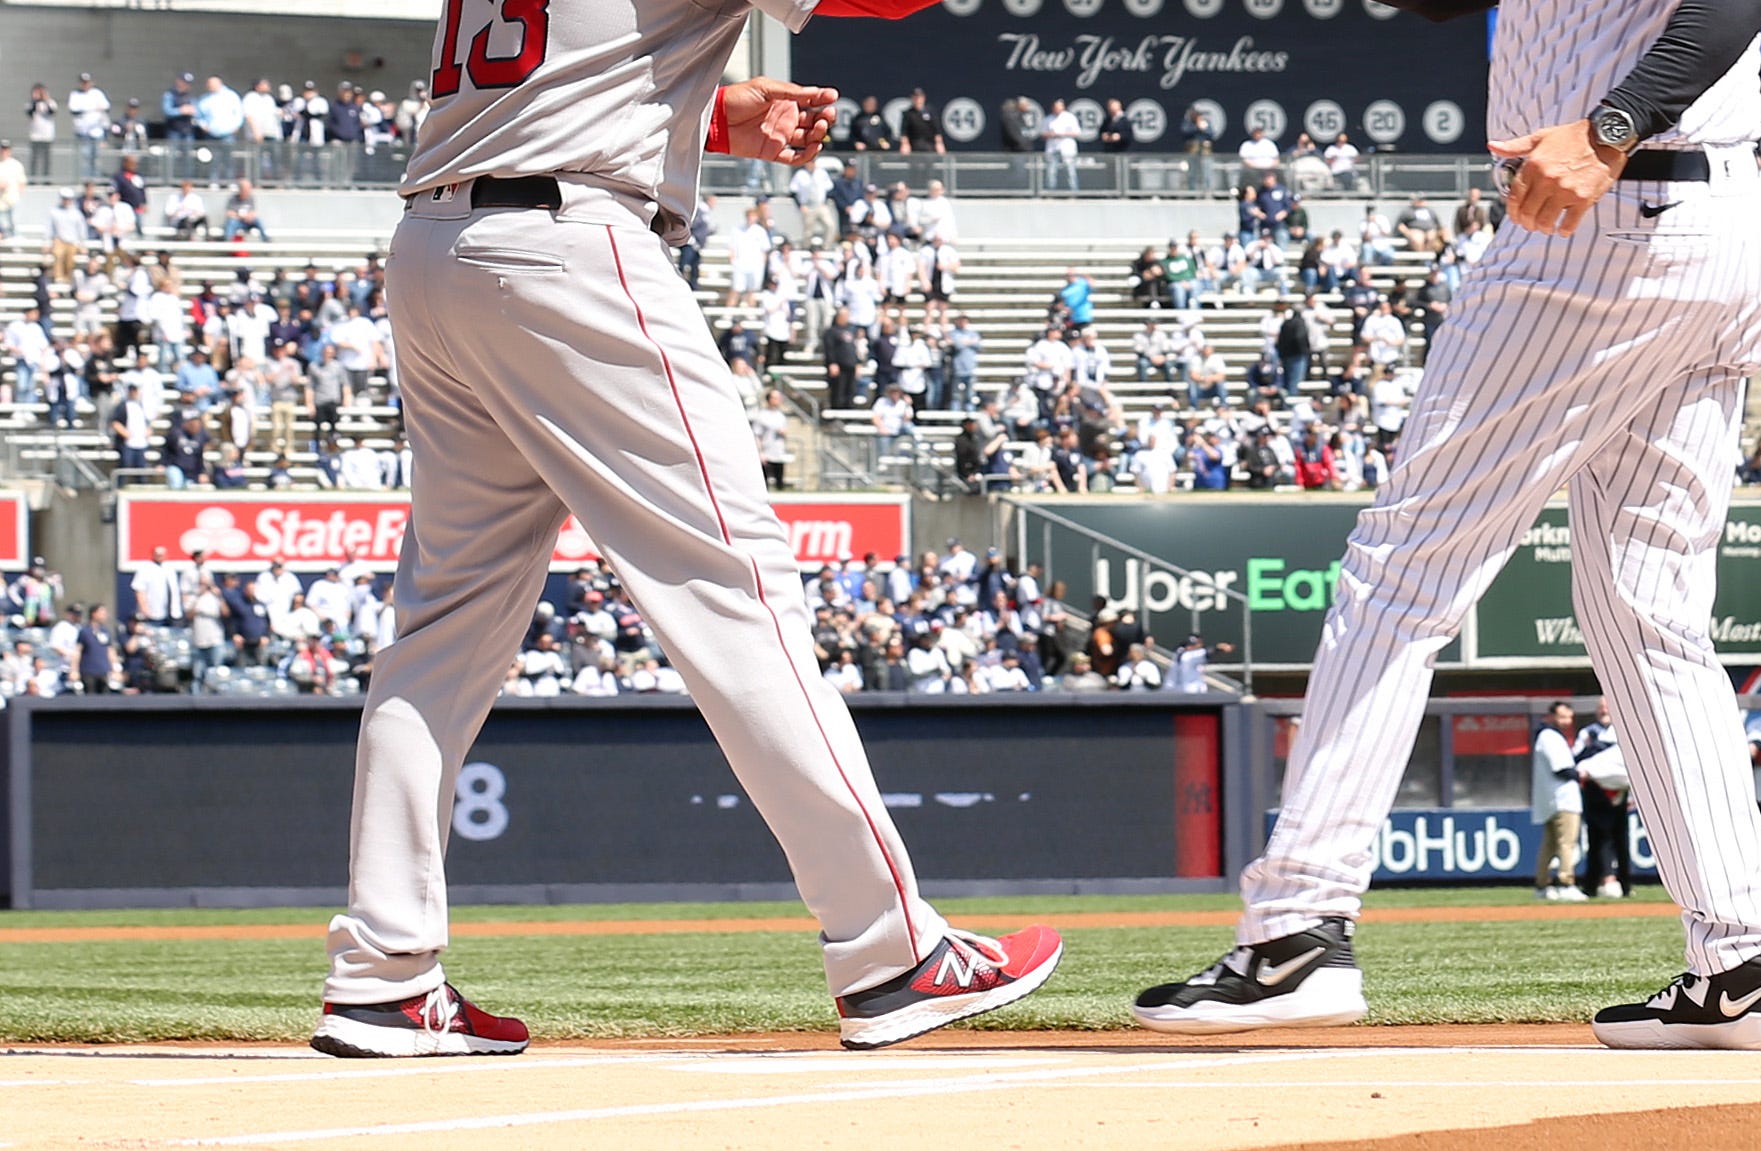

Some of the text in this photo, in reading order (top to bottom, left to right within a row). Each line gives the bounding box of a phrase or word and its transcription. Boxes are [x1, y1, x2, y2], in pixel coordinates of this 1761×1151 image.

[997, 32, 1289, 90] New York Yankees
[950, 108, 976, 129] 44
[1371, 111, 1397, 131] 20
[253, 508, 408, 558] StateF
[1096, 558, 1341, 612] Uber Eat
[453, 762, 510, 841] 8
[1371, 816, 1520, 872] bHub
